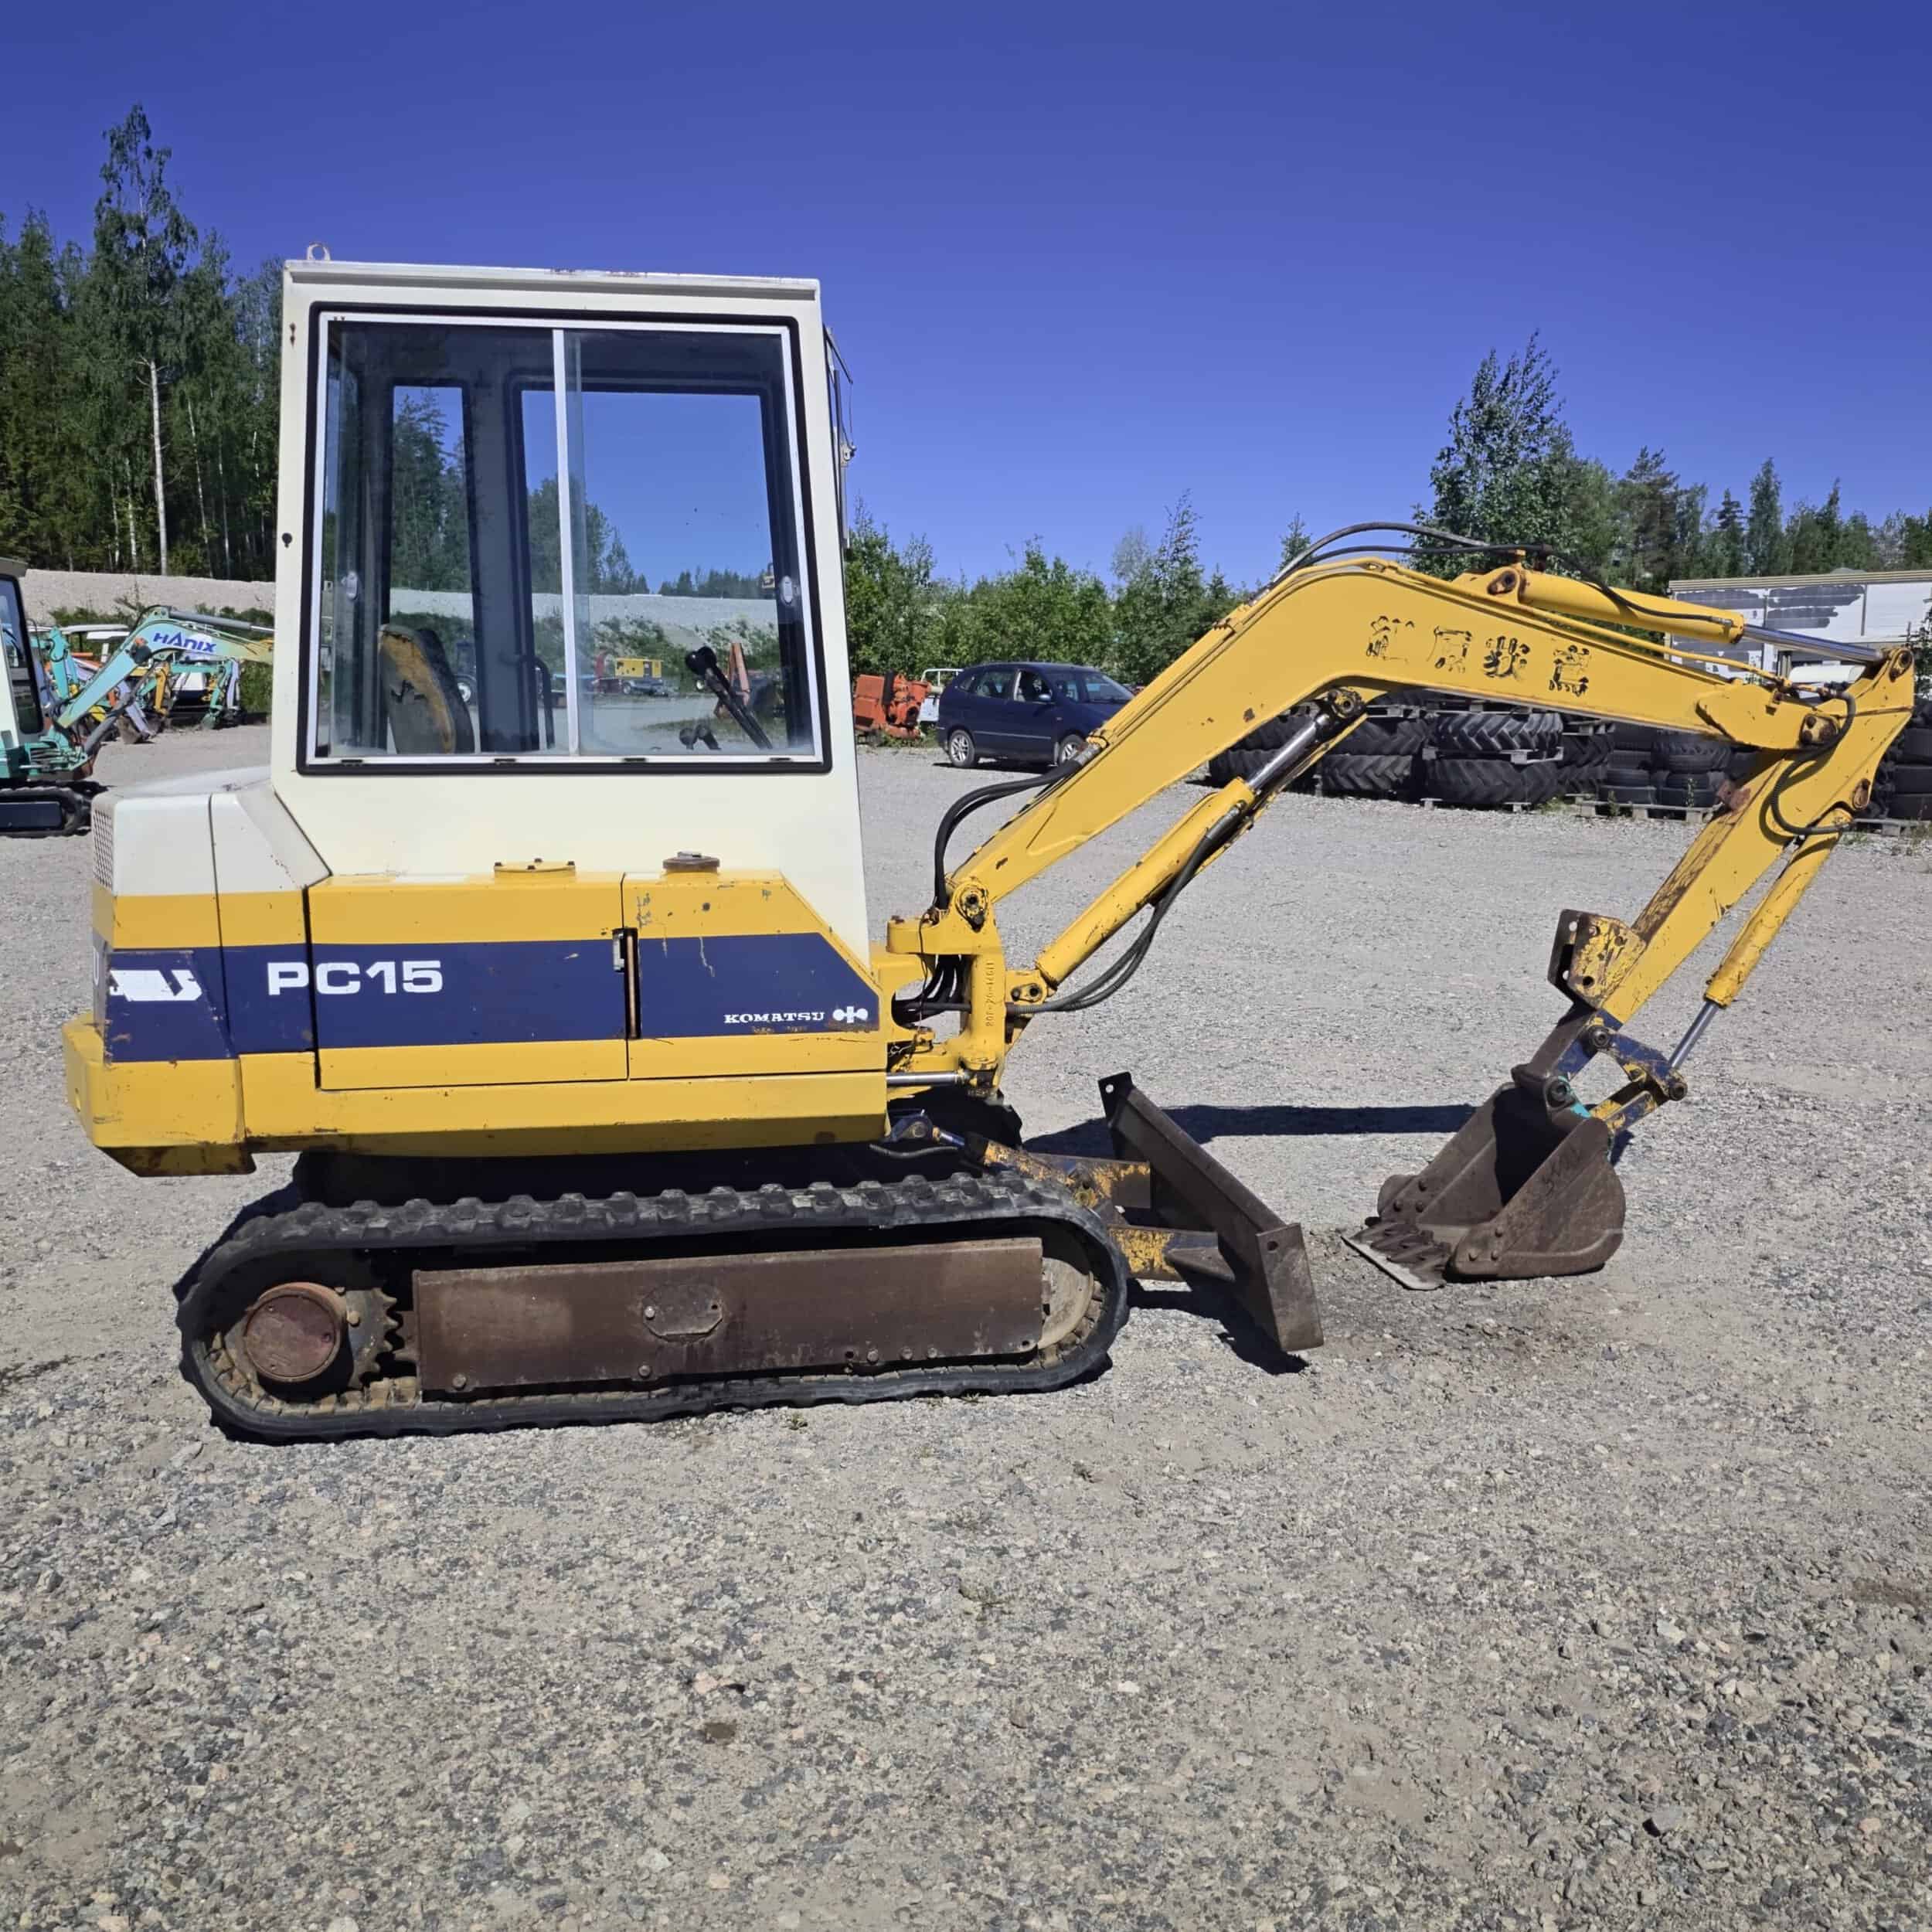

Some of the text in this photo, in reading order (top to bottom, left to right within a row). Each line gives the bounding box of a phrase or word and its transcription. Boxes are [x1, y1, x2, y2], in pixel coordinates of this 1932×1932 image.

[153, 631, 216, 652] HANIX
[267, 960, 443, 995] PC15
[723, 1011, 825, 1024] KOMATSU
